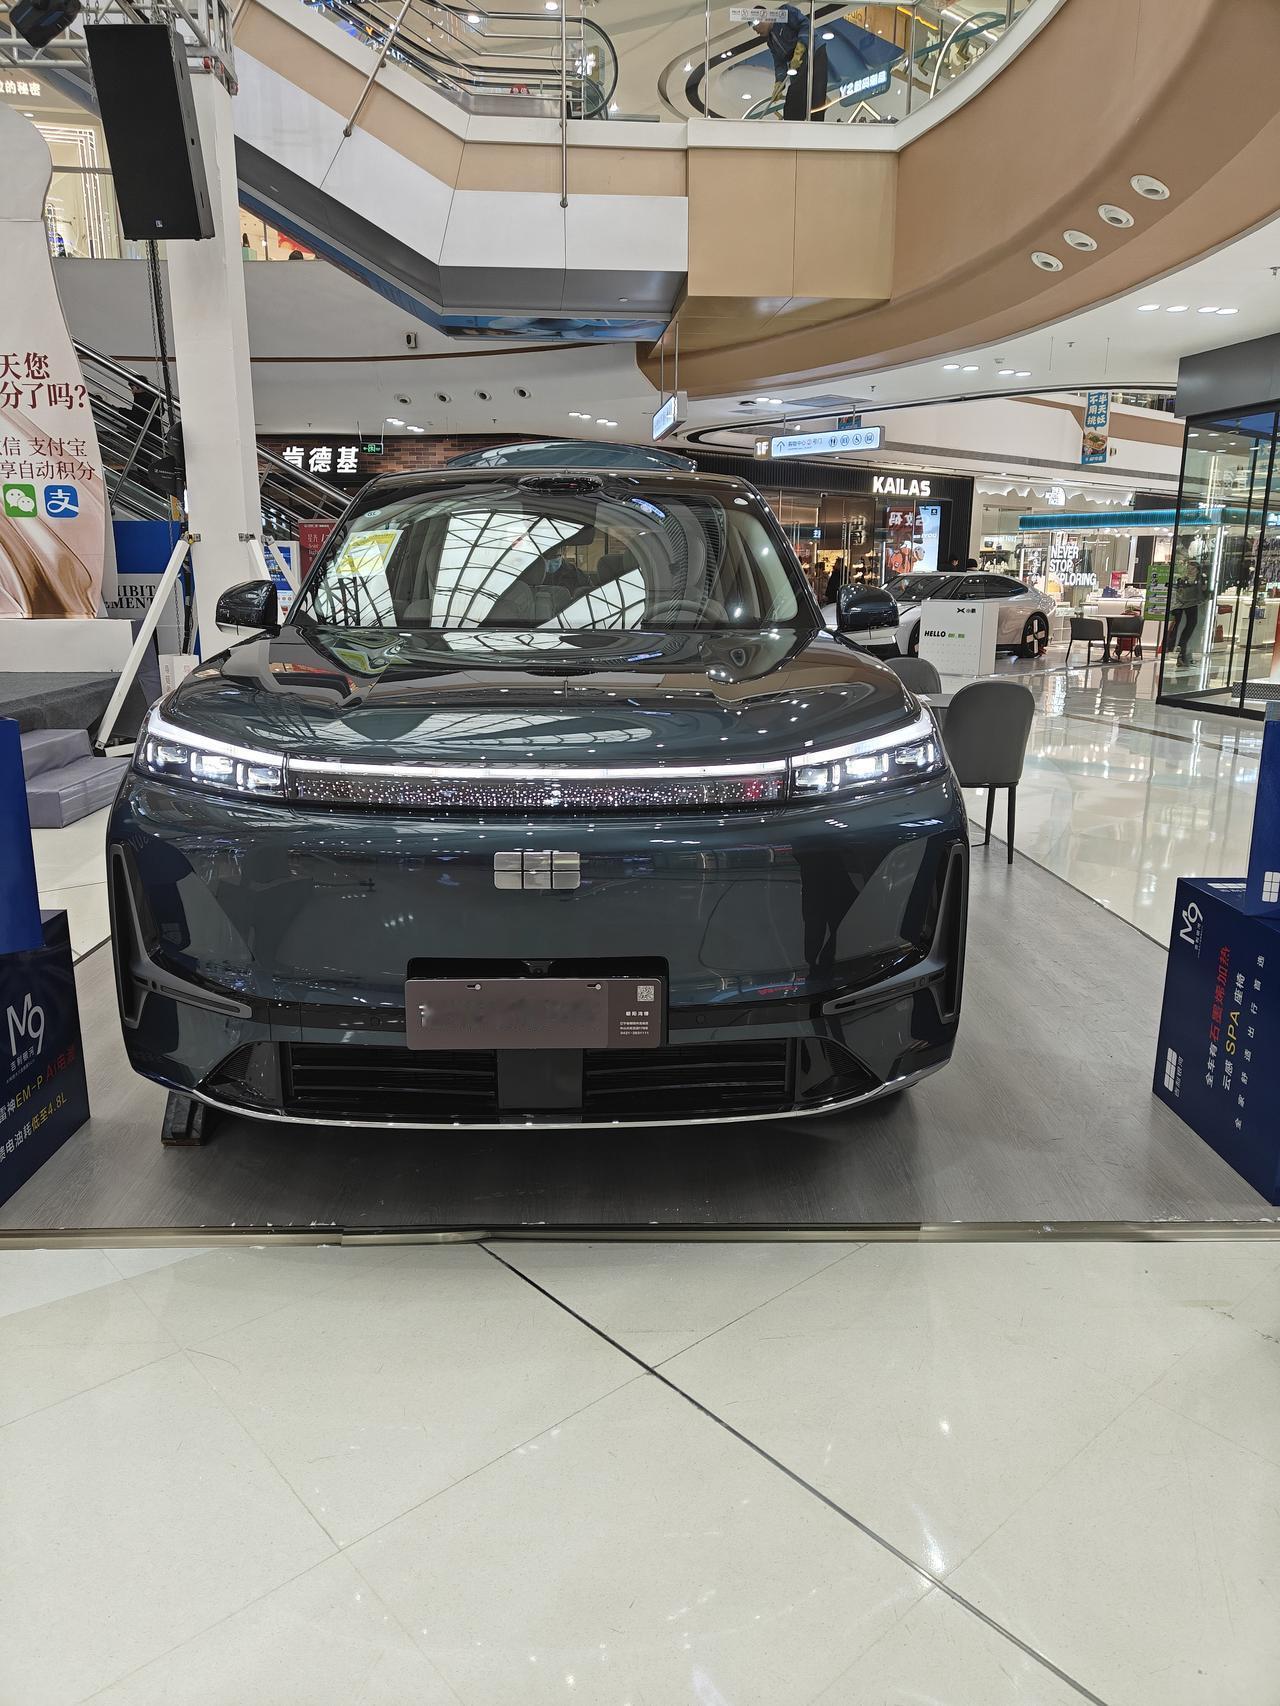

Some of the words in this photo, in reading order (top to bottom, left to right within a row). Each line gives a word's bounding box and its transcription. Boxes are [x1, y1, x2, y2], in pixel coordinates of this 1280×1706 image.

[0, 352, 50, 380] 天您
[0, 436, 21, 456] 信
[27, 437, 87, 457] 支付宝
[0, 459, 96, 481] 享自动积分
[283, 446, 359, 473] 肯德基
[872, 476, 931, 497] KAILAS
[1051, 545, 1079, 559] NEVER
[924, 630, 946, 638] HELLO
[6, 993, 46, 1056] M9
[1225, 1011, 1241, 1056] SPA
